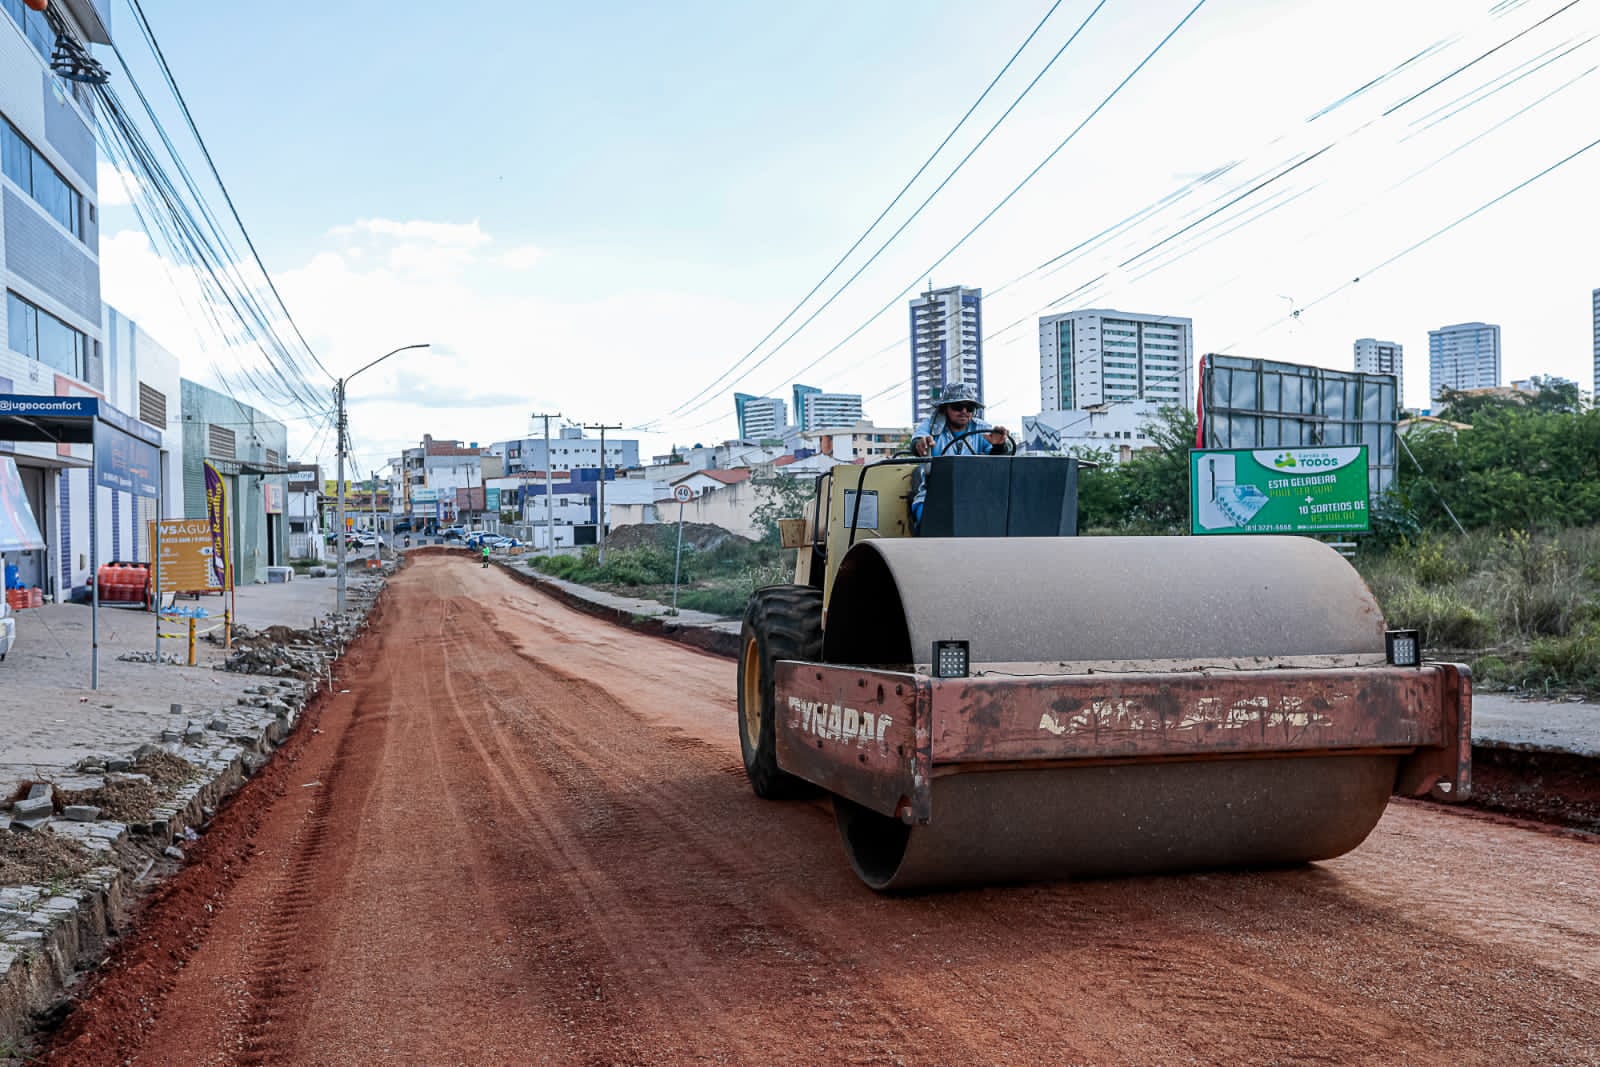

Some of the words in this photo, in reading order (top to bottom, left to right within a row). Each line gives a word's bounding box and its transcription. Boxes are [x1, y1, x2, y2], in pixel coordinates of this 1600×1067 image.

[1299, 458, 1338, 467] TODOS
[1268, 479, 1289, 489] ESTA
[1291, 474, 1337, 487] GELADEIRA
[677, 488, 689, 497] 40
[1298, 505, 1309, 515] 10
[1310, 501, 1352, 514] SORTEIOS
[1354, 500, 1365, 510] DE
